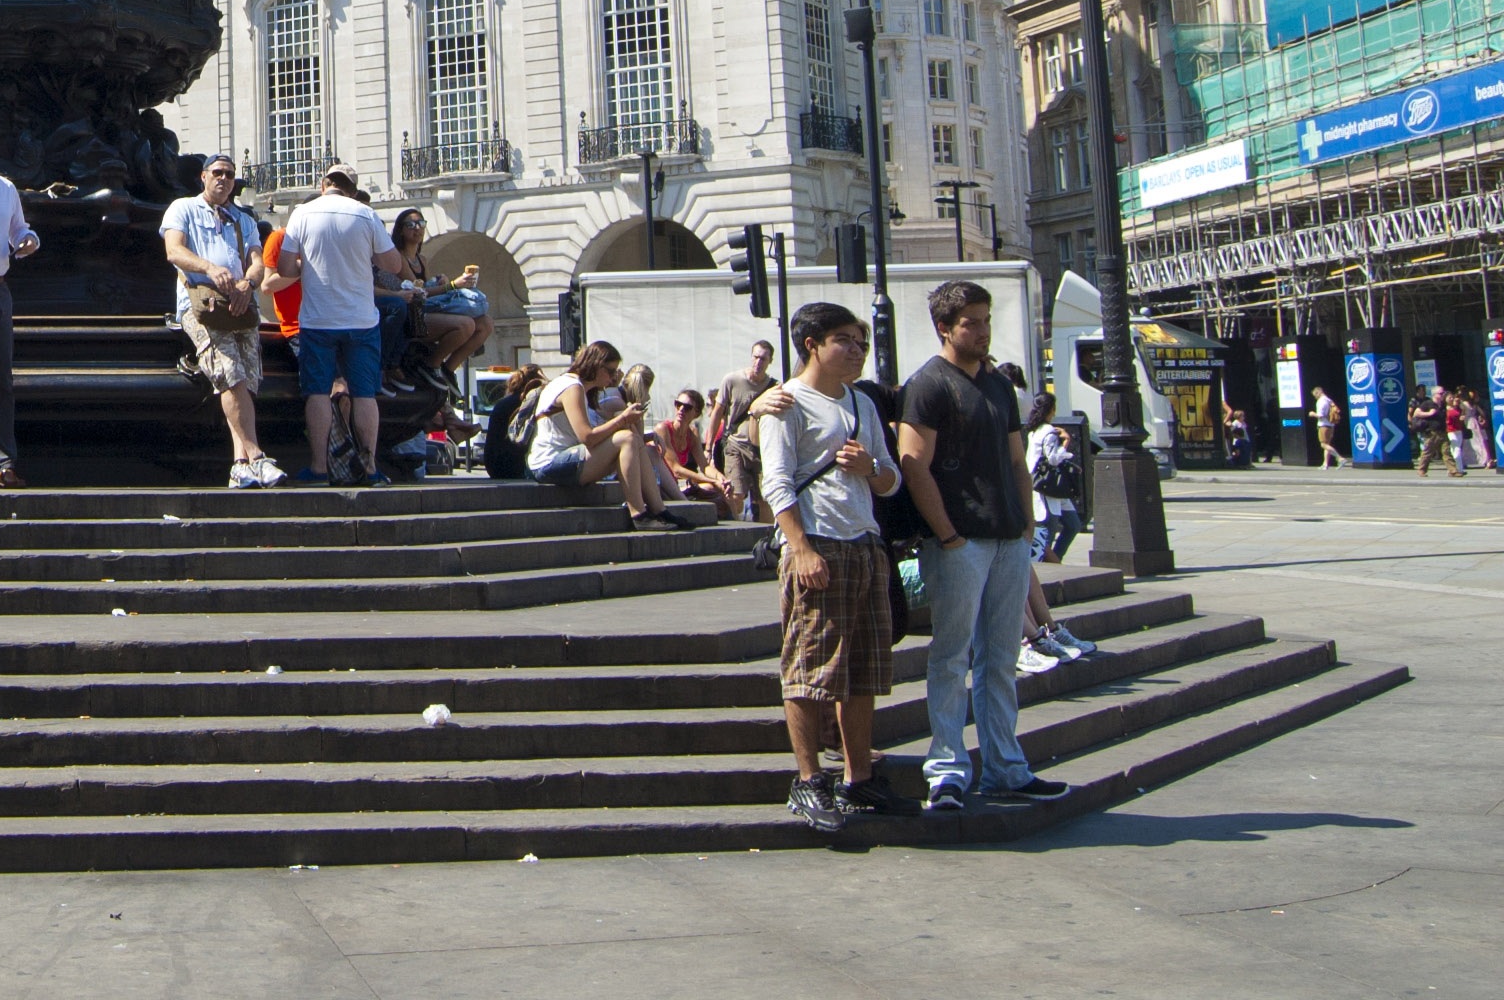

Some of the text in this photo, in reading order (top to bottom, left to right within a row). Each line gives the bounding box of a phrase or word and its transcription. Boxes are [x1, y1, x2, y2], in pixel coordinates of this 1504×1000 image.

[1407, 96, 1434, 127] Boots
[1323, 113, 1398, 142] midnight pharmacy
[1184, 164, 1205, 180] OPEN
[1207, 160, 1216, 173] AS
[1217, 153, 1243, 171] USUAL
